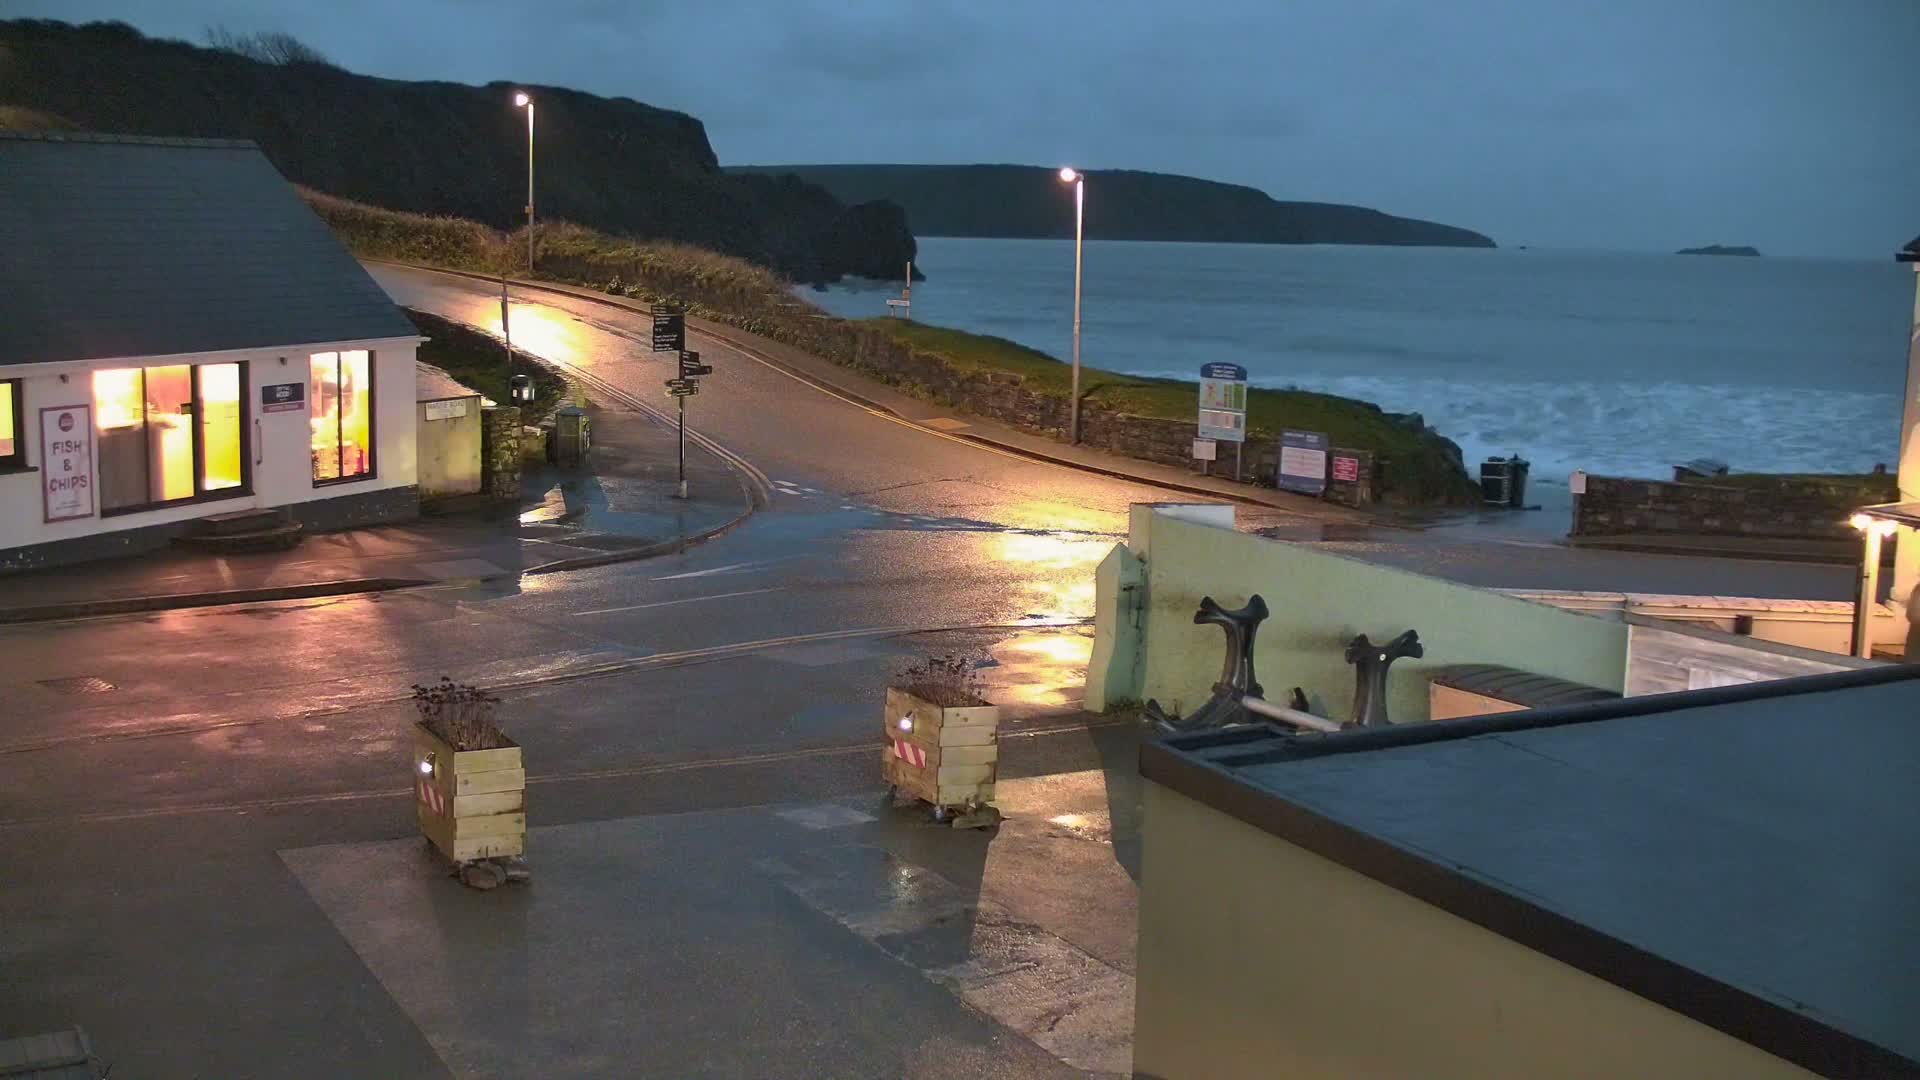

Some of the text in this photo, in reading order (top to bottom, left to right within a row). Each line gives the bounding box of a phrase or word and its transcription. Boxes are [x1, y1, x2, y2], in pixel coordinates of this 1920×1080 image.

[52, 440, 82, 455] FISH
[63, 459, 72, 472] &
[49, 475, 88, 492] CHIPS
